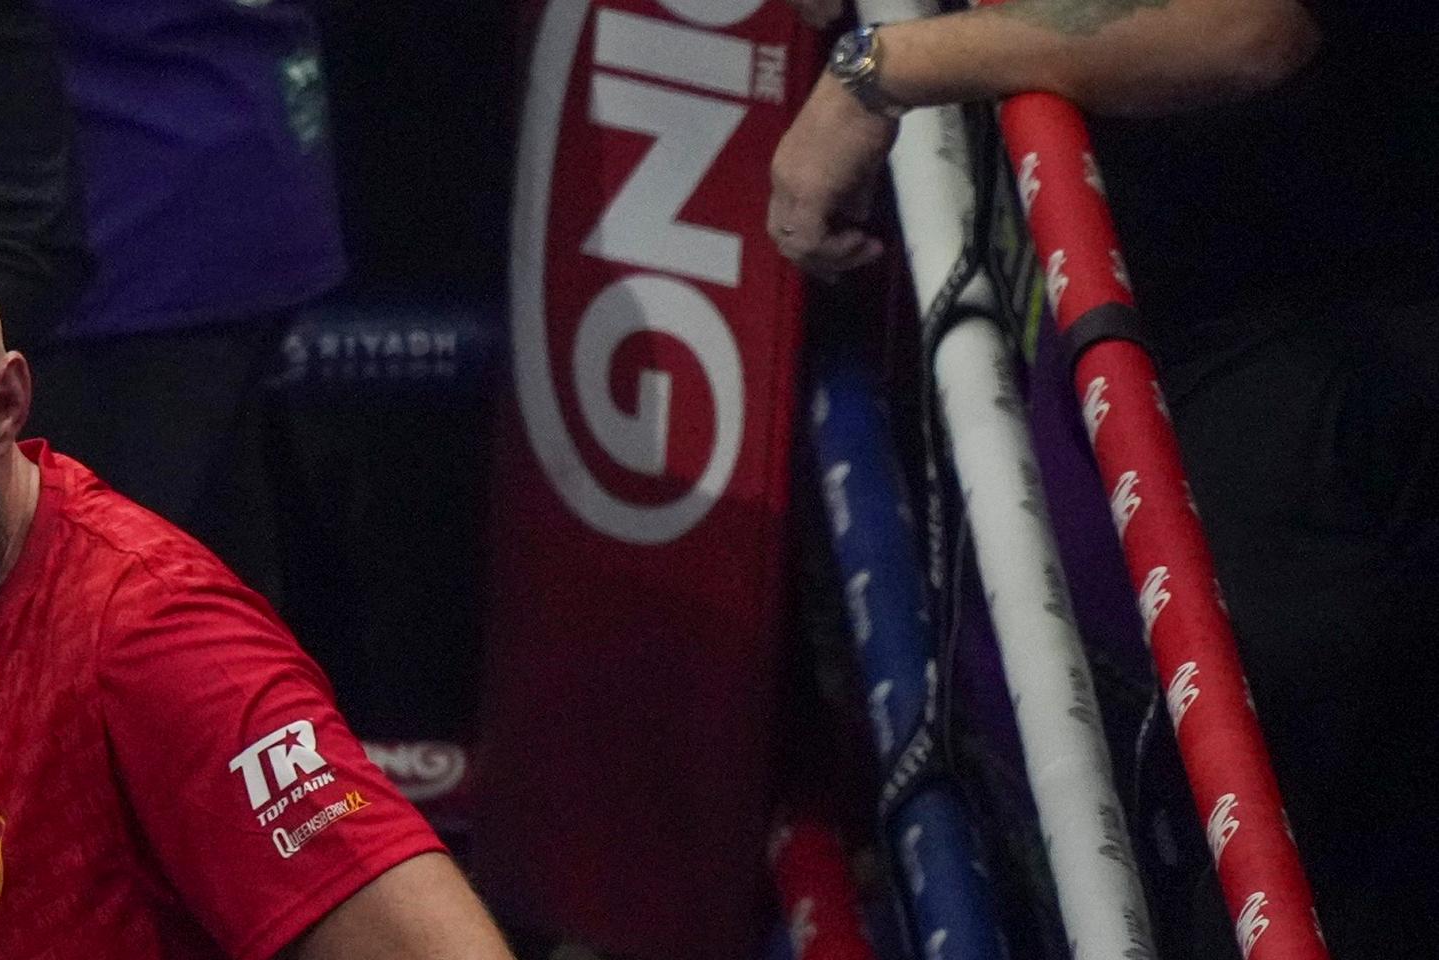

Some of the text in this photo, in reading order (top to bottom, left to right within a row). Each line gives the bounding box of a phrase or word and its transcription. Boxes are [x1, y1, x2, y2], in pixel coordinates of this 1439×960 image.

[510, 0, 762, 545] ING
[256, 770, 336, 827] TOP RANK
